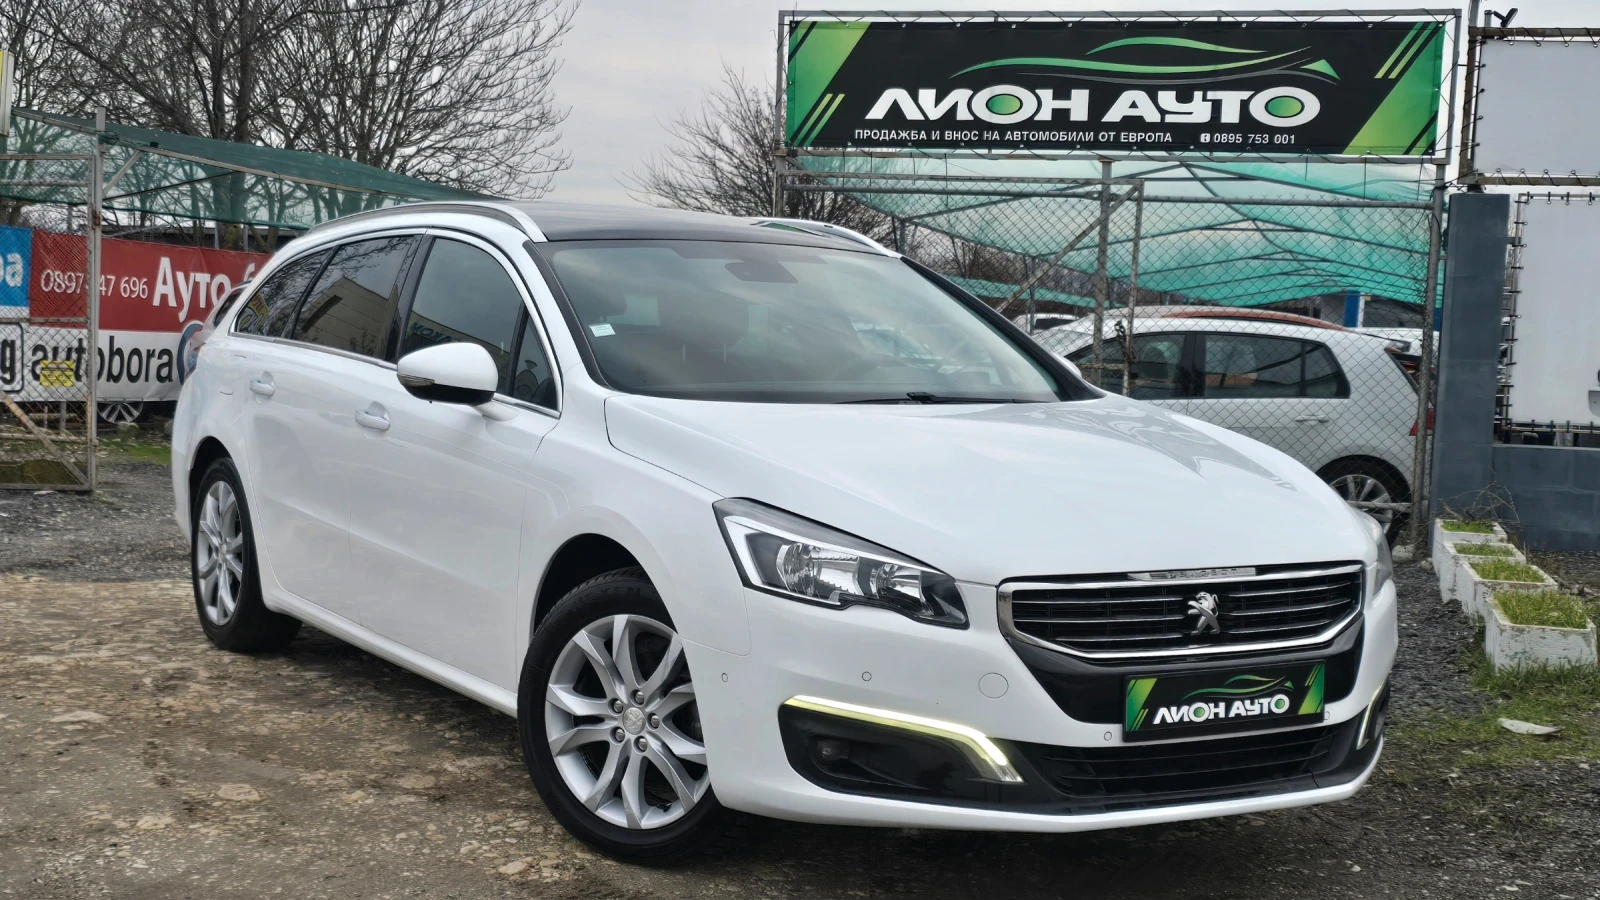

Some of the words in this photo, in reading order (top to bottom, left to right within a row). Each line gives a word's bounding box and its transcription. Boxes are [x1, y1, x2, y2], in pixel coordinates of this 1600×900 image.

[864, 84, 1090, 124] ЛИОН
[1101, 86, 1321, 127] АУТО
[855, 129, 927, 141] ПРОДАЖБА
[931, 130, 940, 140] И
[945, 130, 979, 140] ВНОС
[984, 131, 1000, 140] НА
[1004, 131, 1094, 142] АВТОМОБИЛИ
[1098, 131, 1116, 142] ОТ
[1120, 132, 1172, 143] ЕВРОПА
[1213, 133, 1243, 143] 0895
[1247, 134, 1269, 144] 753
[1274, 134, 1295, 144] 001
[0, 253, 23, 287] а
[41, 269, 84, 294] 0897
[120, 276, 148, 299] 696
[153, 256, 232, 323] Ауто
[1152, 702, 1226, 725] ЛИОН
[1228, 693, 1290, 718] АУТО
